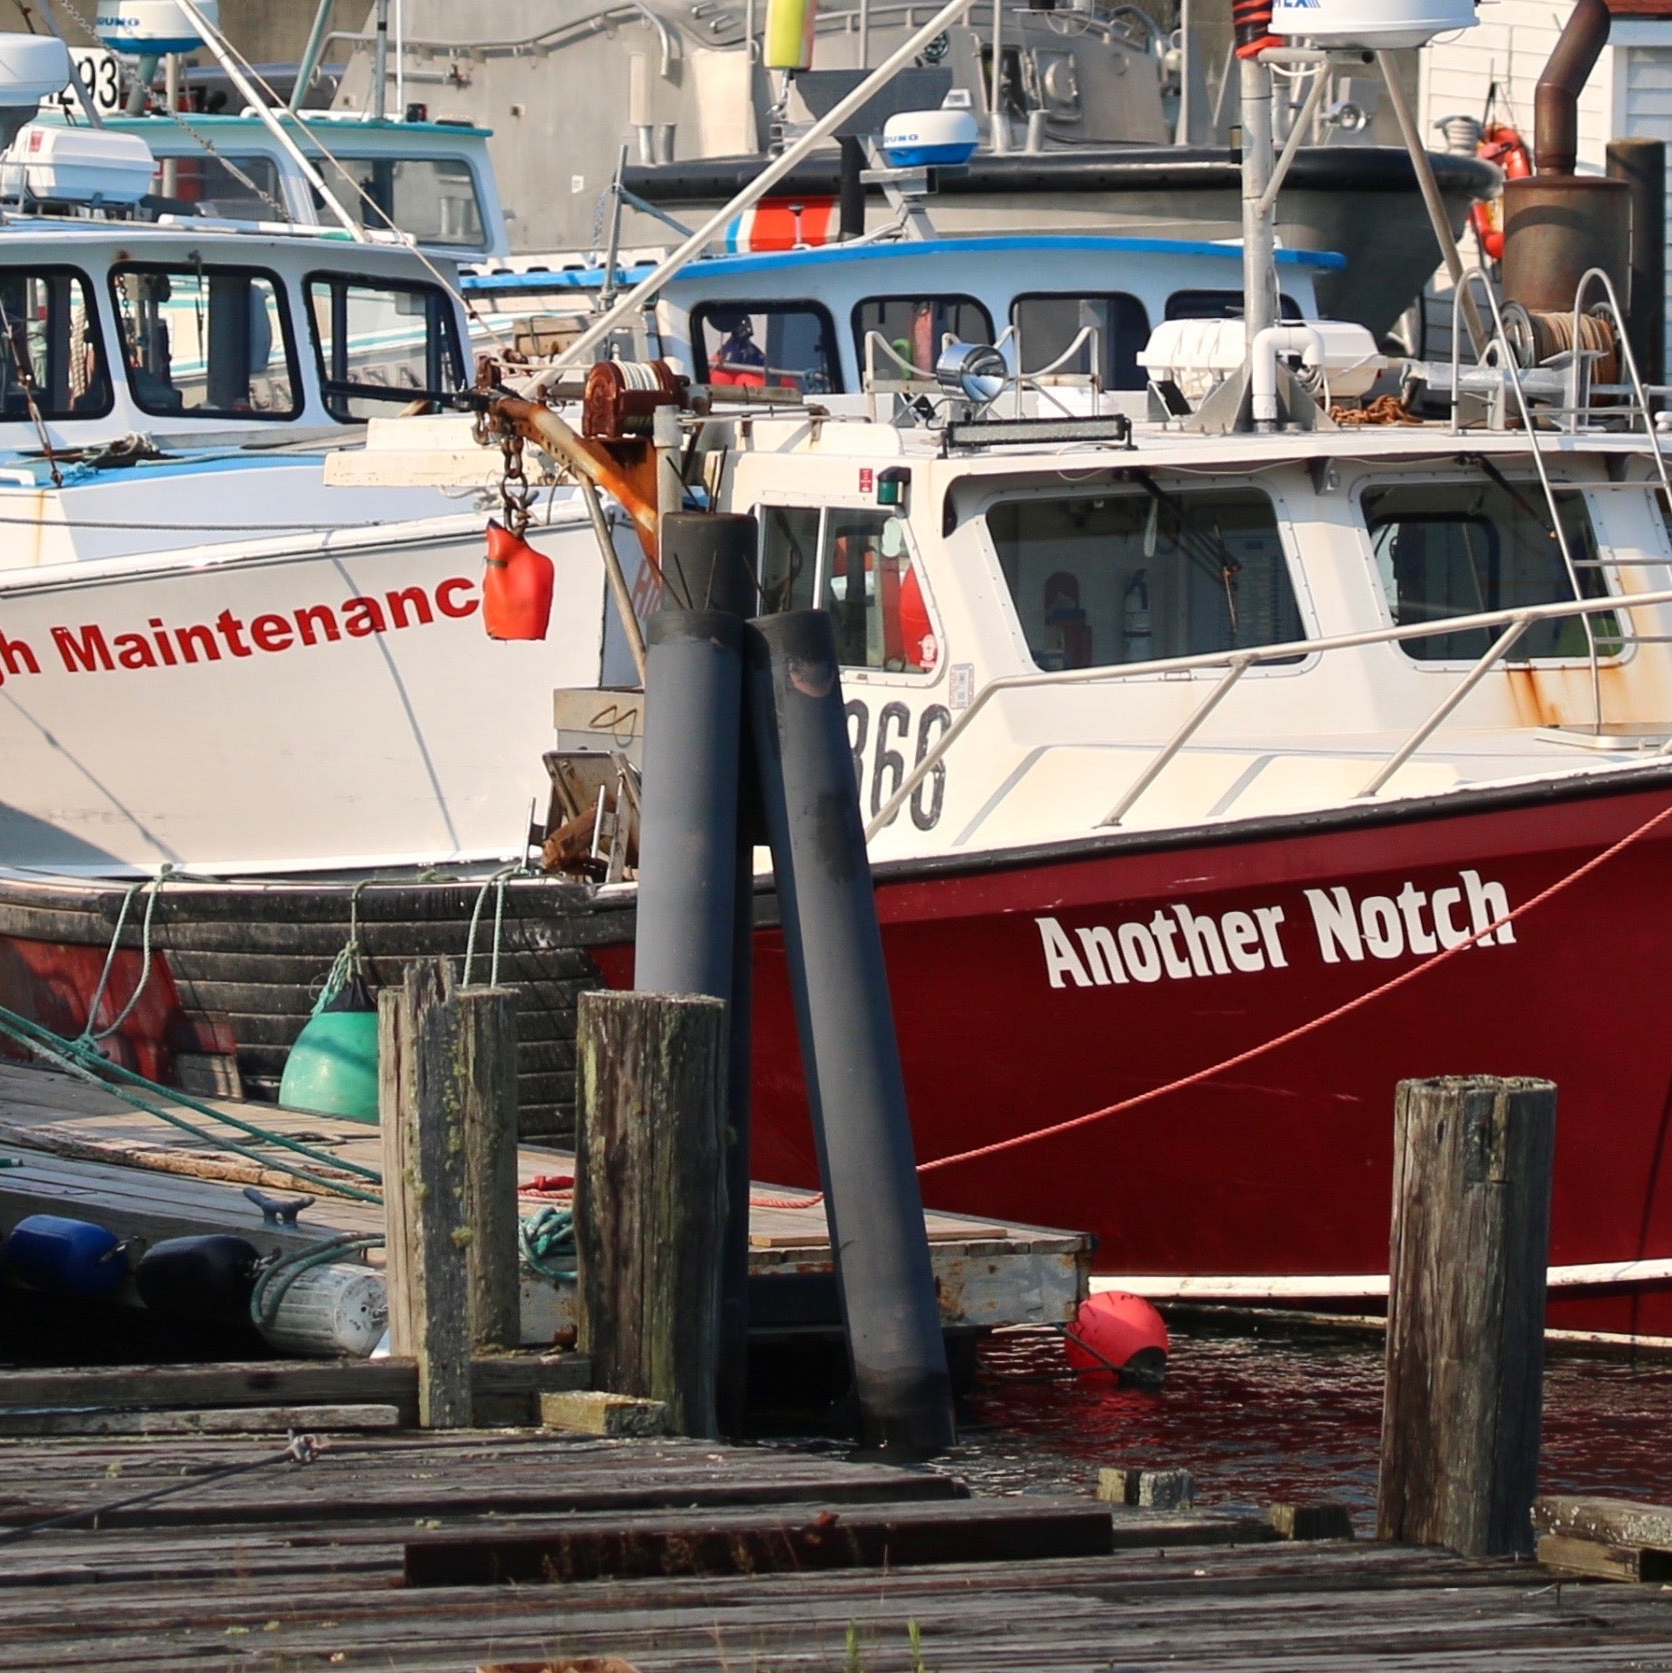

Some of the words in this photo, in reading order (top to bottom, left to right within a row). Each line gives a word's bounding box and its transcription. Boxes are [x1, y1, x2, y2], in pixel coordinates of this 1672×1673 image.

[96, 16, 140, 27] RUNO
[49, 577, 481, 673] Maintenanc
[1034, 903, 1289, 989] Another
[1302, 869, 1518, 964] Notch
